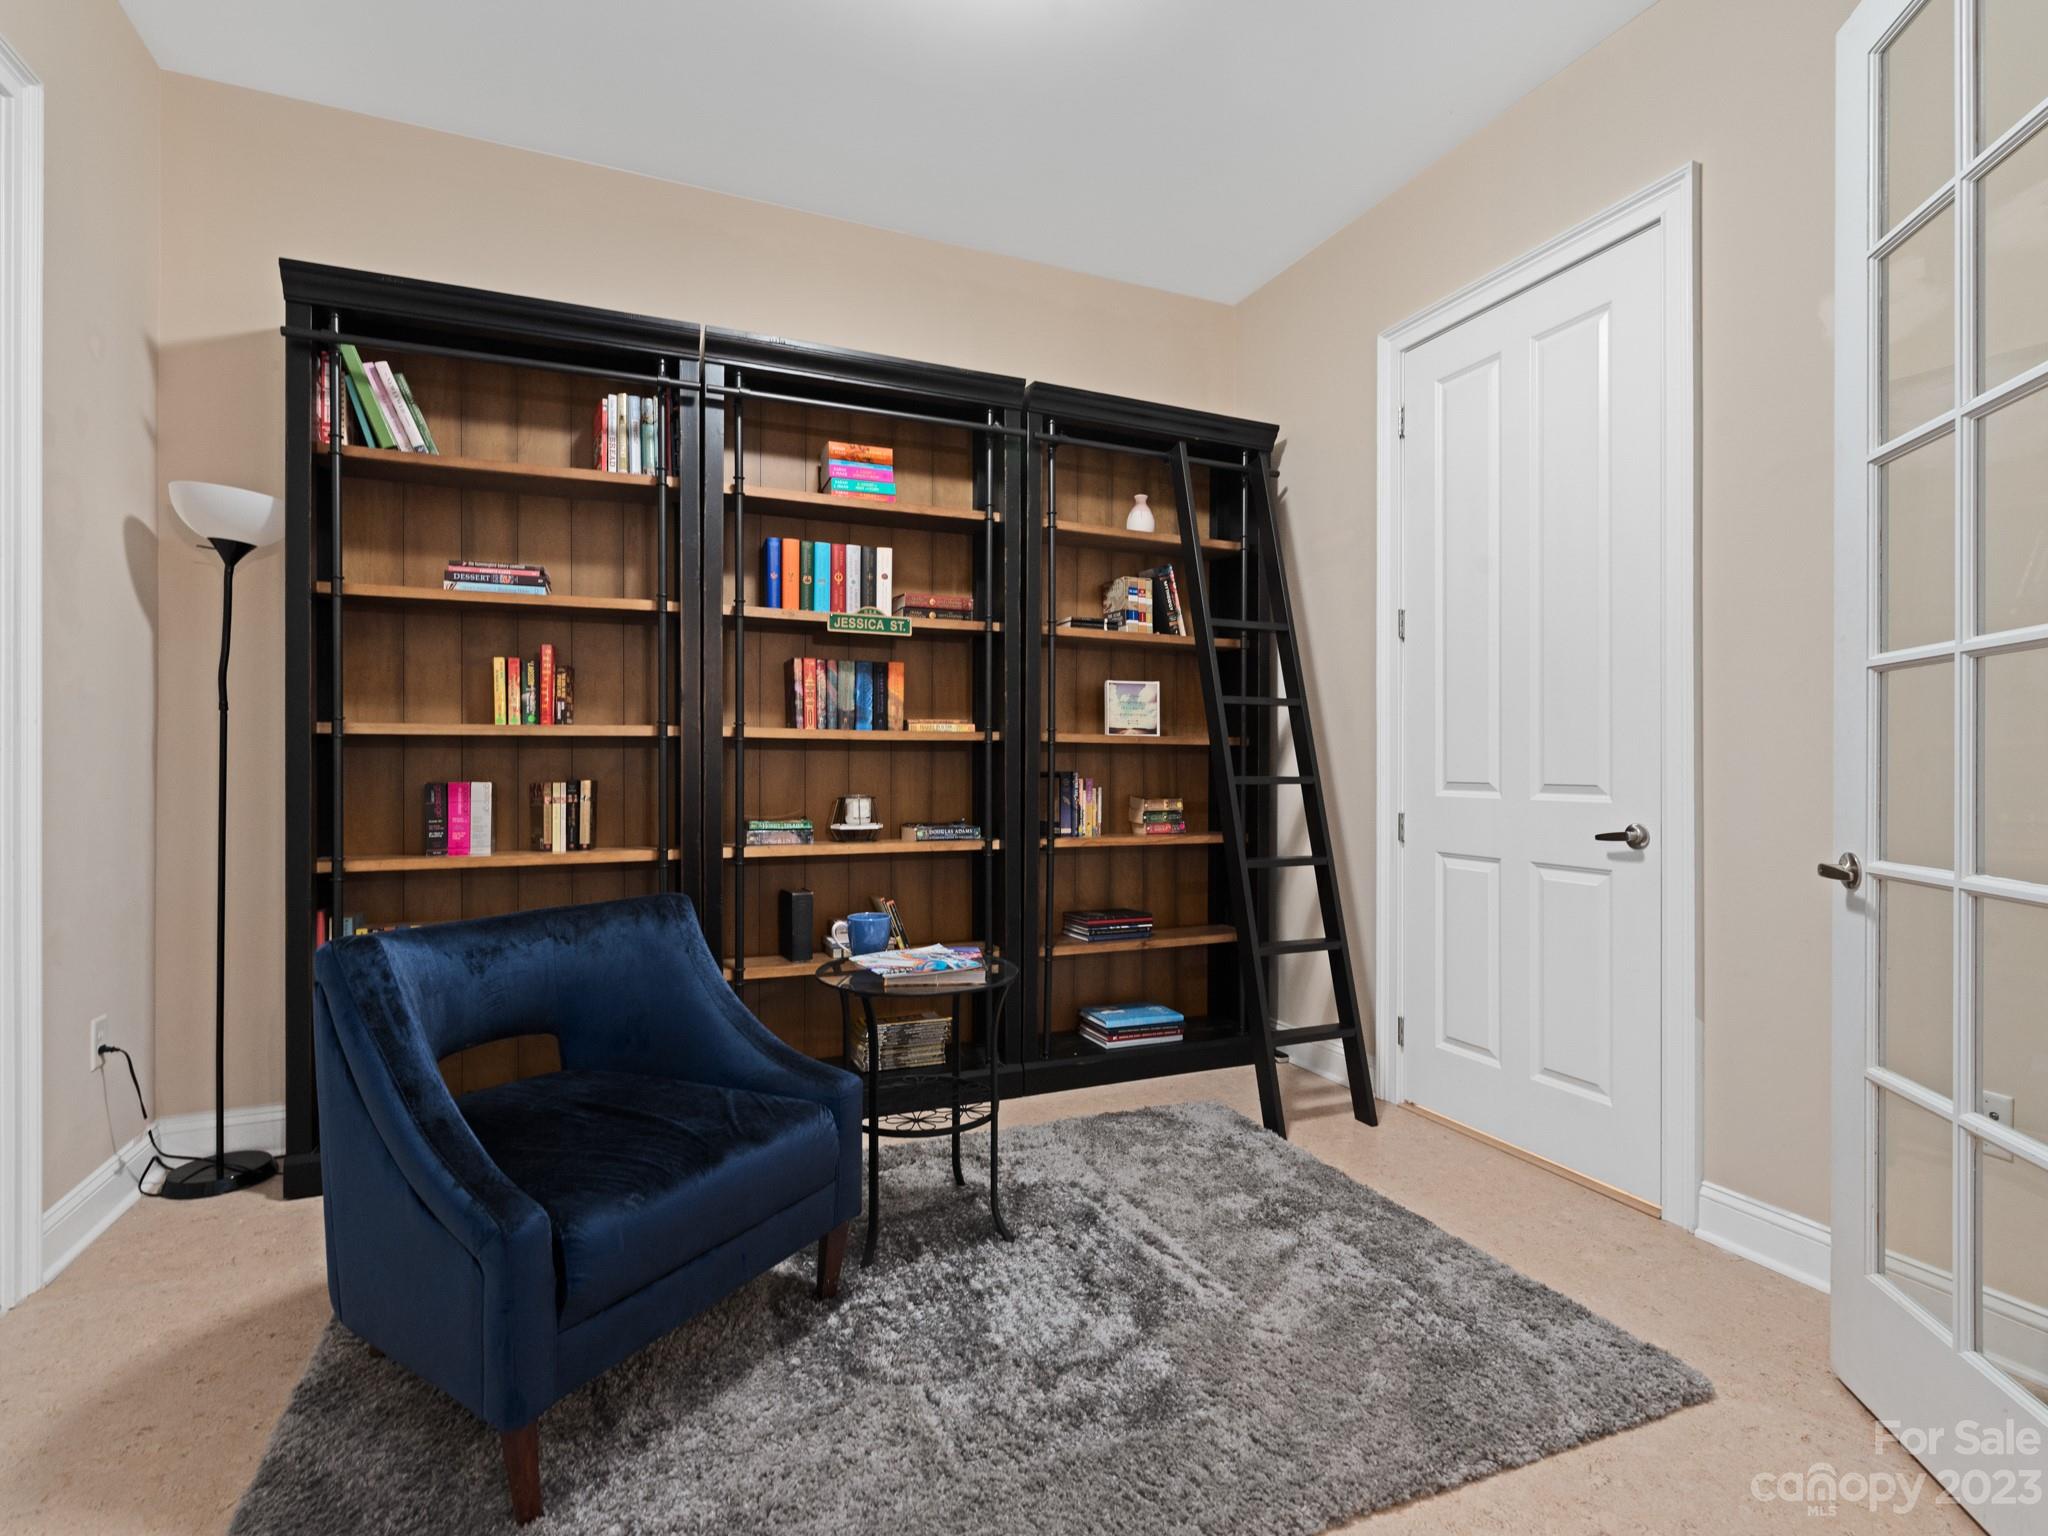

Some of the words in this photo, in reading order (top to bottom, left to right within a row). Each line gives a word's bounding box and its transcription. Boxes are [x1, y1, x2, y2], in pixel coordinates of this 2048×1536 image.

[453, 572, 490, 582] DESSERT
[834, 616, 884, 631] JESSICA
[890, 620, 906, 632] ST.
